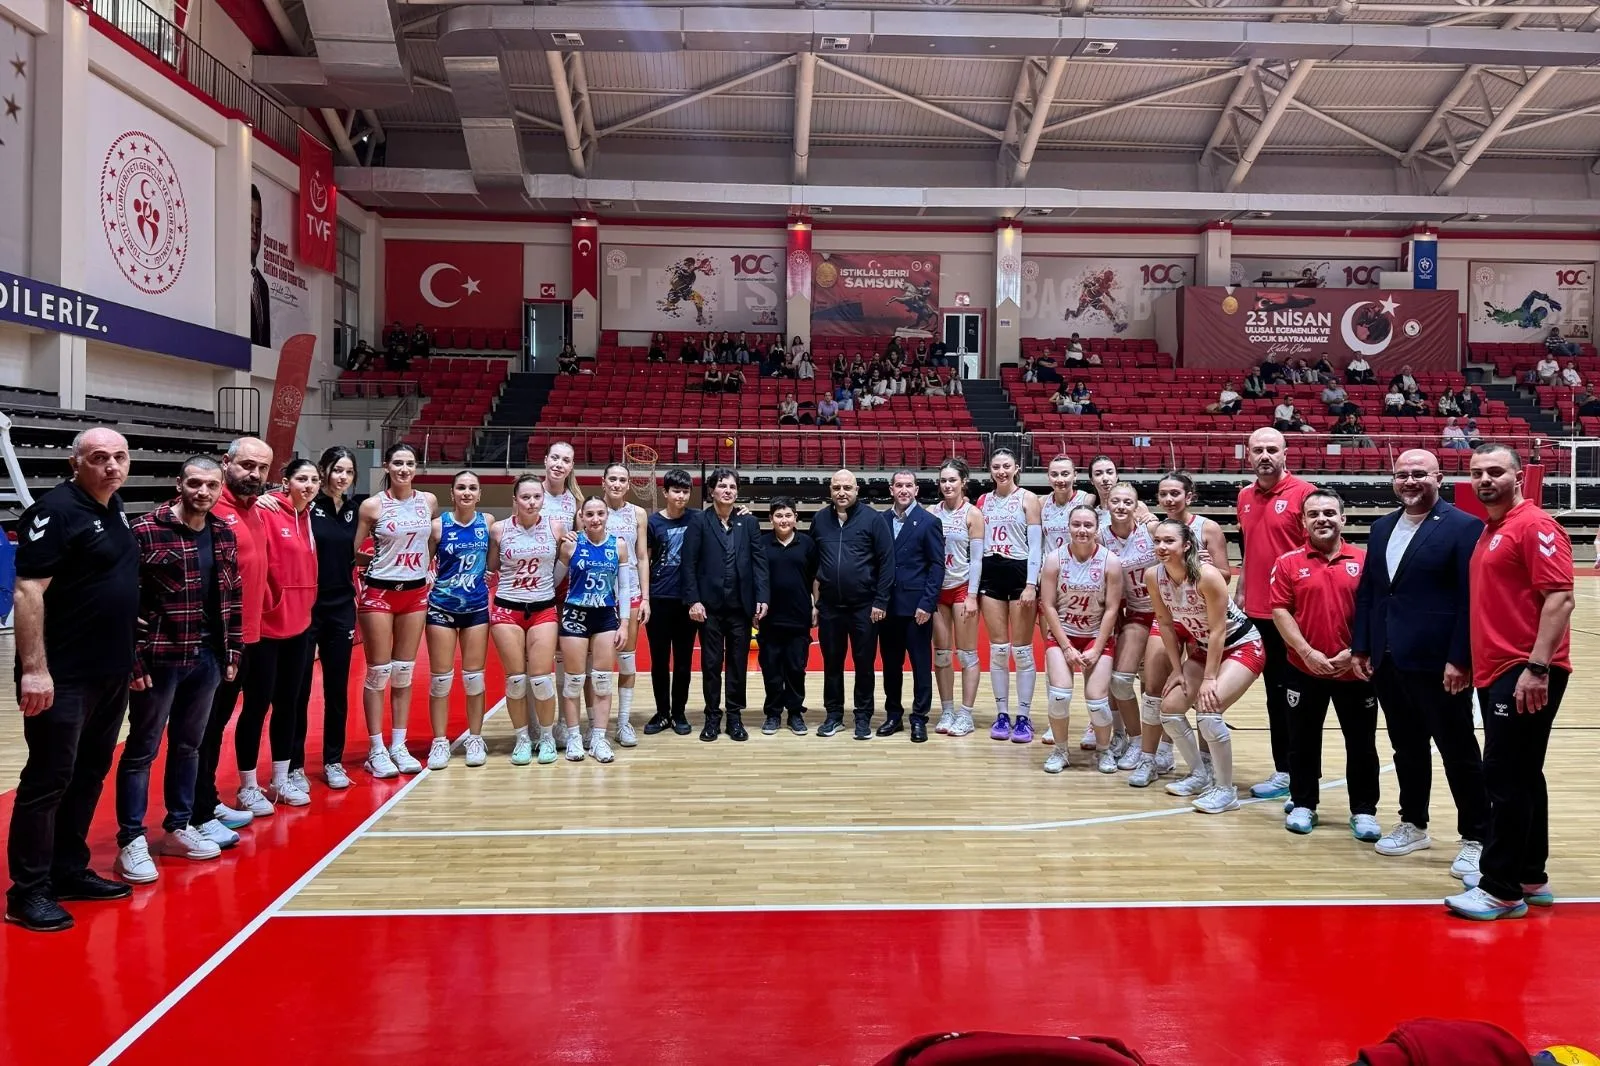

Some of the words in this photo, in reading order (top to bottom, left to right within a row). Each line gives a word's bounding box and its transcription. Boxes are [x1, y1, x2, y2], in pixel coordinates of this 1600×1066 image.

[306, 213, 332, 242] TVF
[541, 286, 555, 296] C4
[844, 277, 905, 289] SAMSUN
[1246, 311, 1268, 326] 23
[1273, 309, 1332, 326] NİSAN
[1245, 326, 1274, 334] ULUSAL
[1275, 326, 1319, 335] EGEMENLİK
[1320, 327, 1331, 335] VE
[1248, 335, 1277, 344] ÇOCUK
[1278, 335, 1329, 343] BAYRAMIMIZ
[406, 532, 417, 549] 7
[992, 525, 1008, 542] 16
[454, 541, 488, 550] KESKIN
[459, 553, 477, 573] 19
[516, 557, 540, 575] 26
[584, 572, 608, 591] 55
[1128, 567, 1145, 586] 17
[1068, 595, 1090, 612] 24
[570, 609, 587, 622] 55
